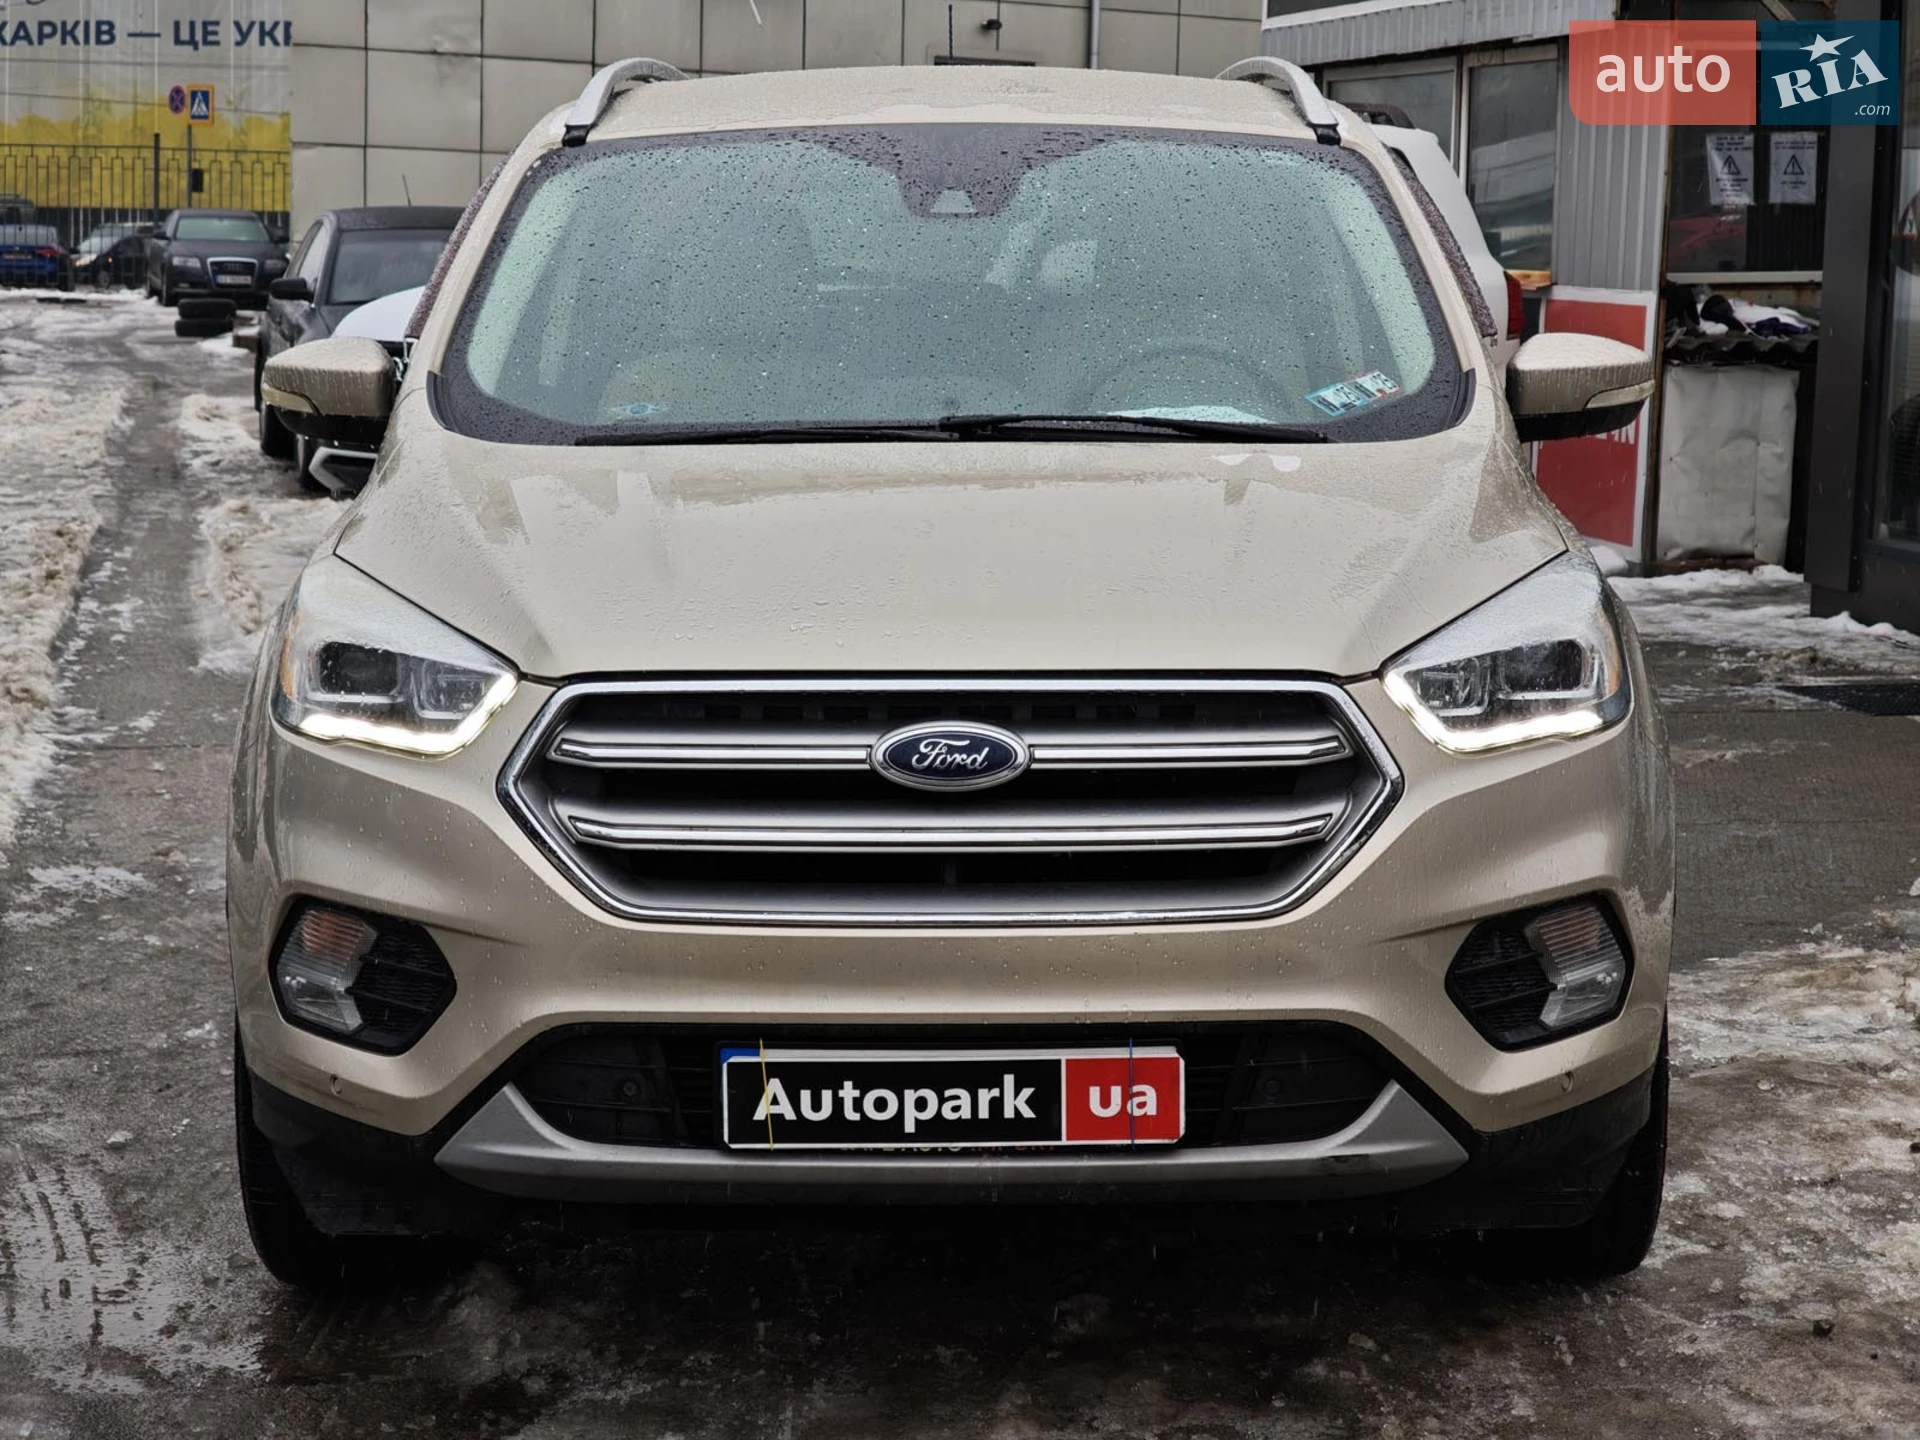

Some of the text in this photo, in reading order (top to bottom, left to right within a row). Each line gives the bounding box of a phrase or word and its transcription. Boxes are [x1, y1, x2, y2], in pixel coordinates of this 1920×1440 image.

[173, 20, 221, 51] ЦЕ
[911, 738, 990, 770] Ford
[753, 1073, 1158, 1134] Autopark ua
